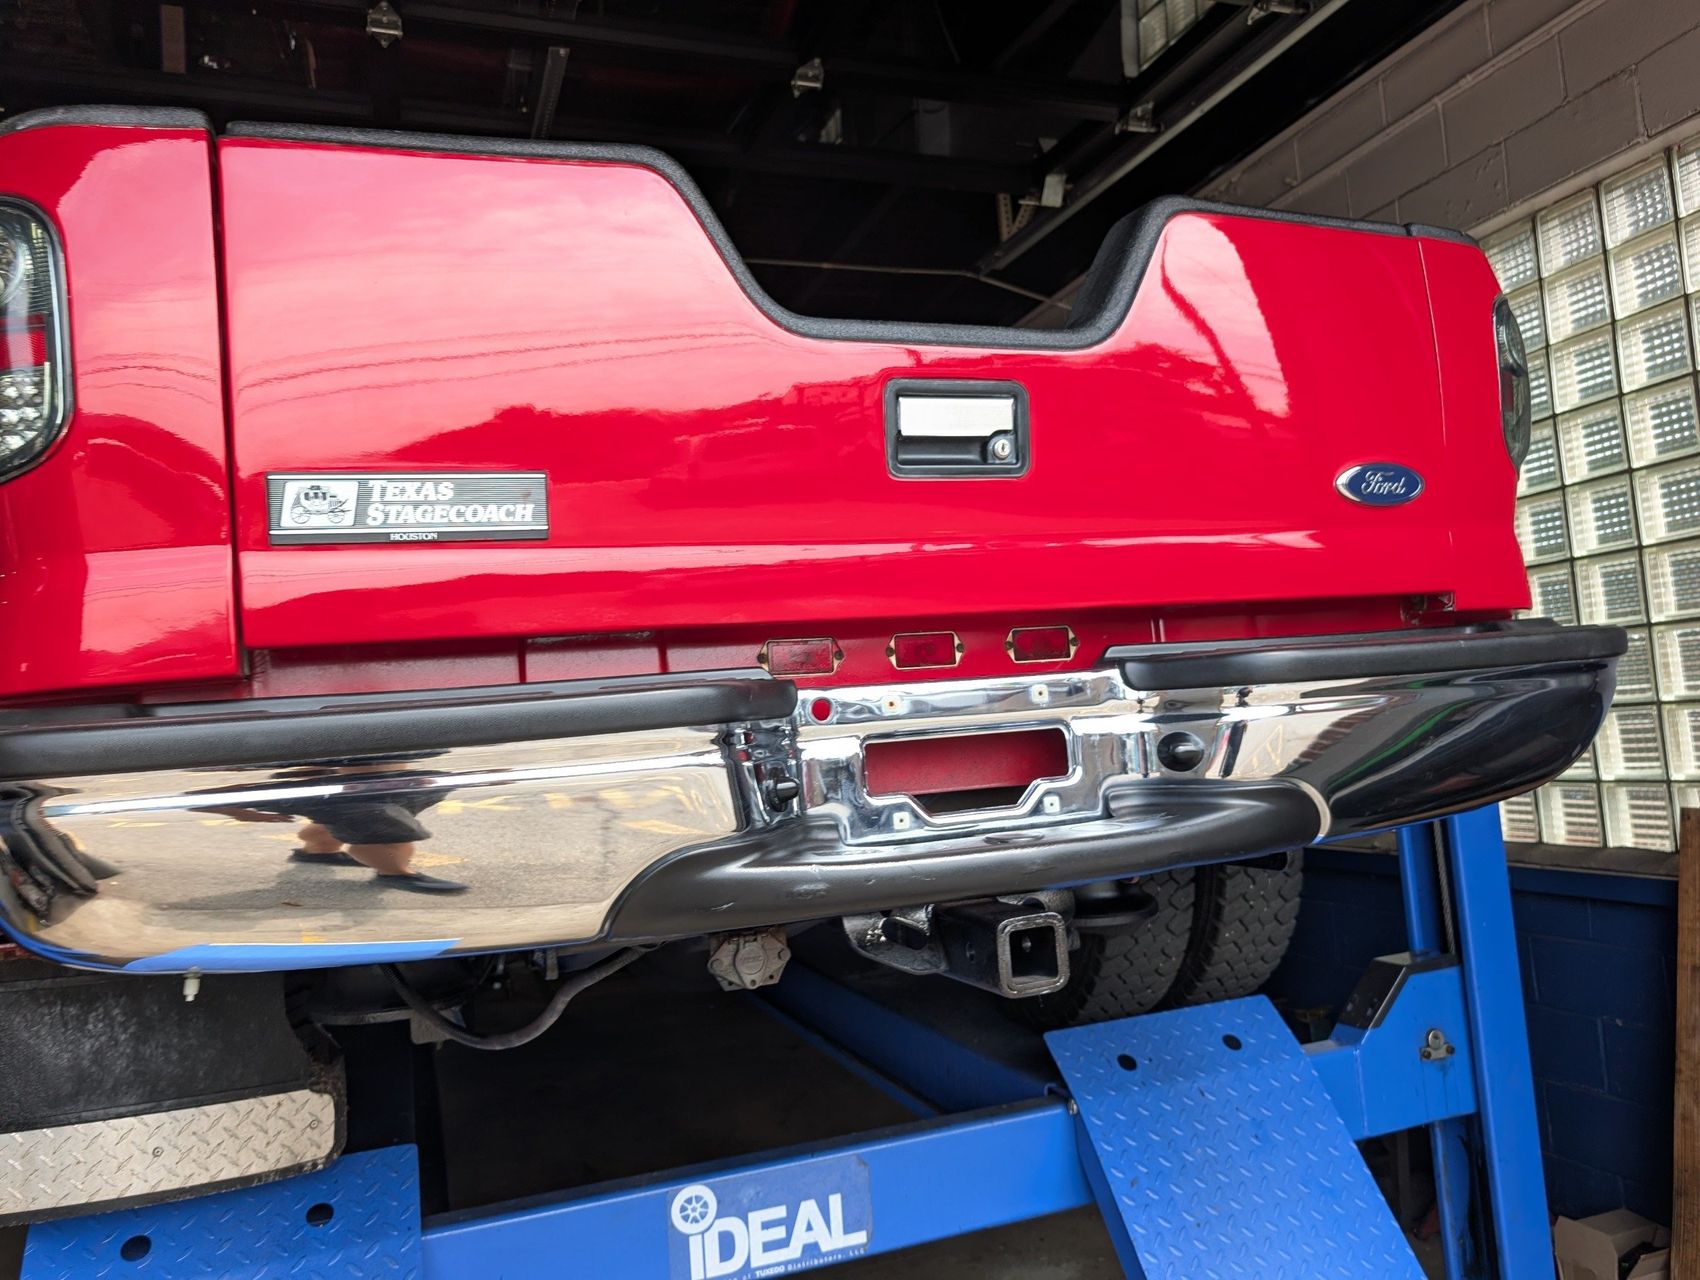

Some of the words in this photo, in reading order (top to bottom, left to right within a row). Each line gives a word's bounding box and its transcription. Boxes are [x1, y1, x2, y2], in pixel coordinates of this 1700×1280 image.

[367, 480, 454, 501] TEXAS
[1361, 470, 1406, 495] Ford
[366, 502, 536, 526] STAGECOACH
[389, 532, 439, 541] HOUSTON
[755, 1264, 786, 1278] TUXEDO
[849, 1247, 865, 1257] LLC
